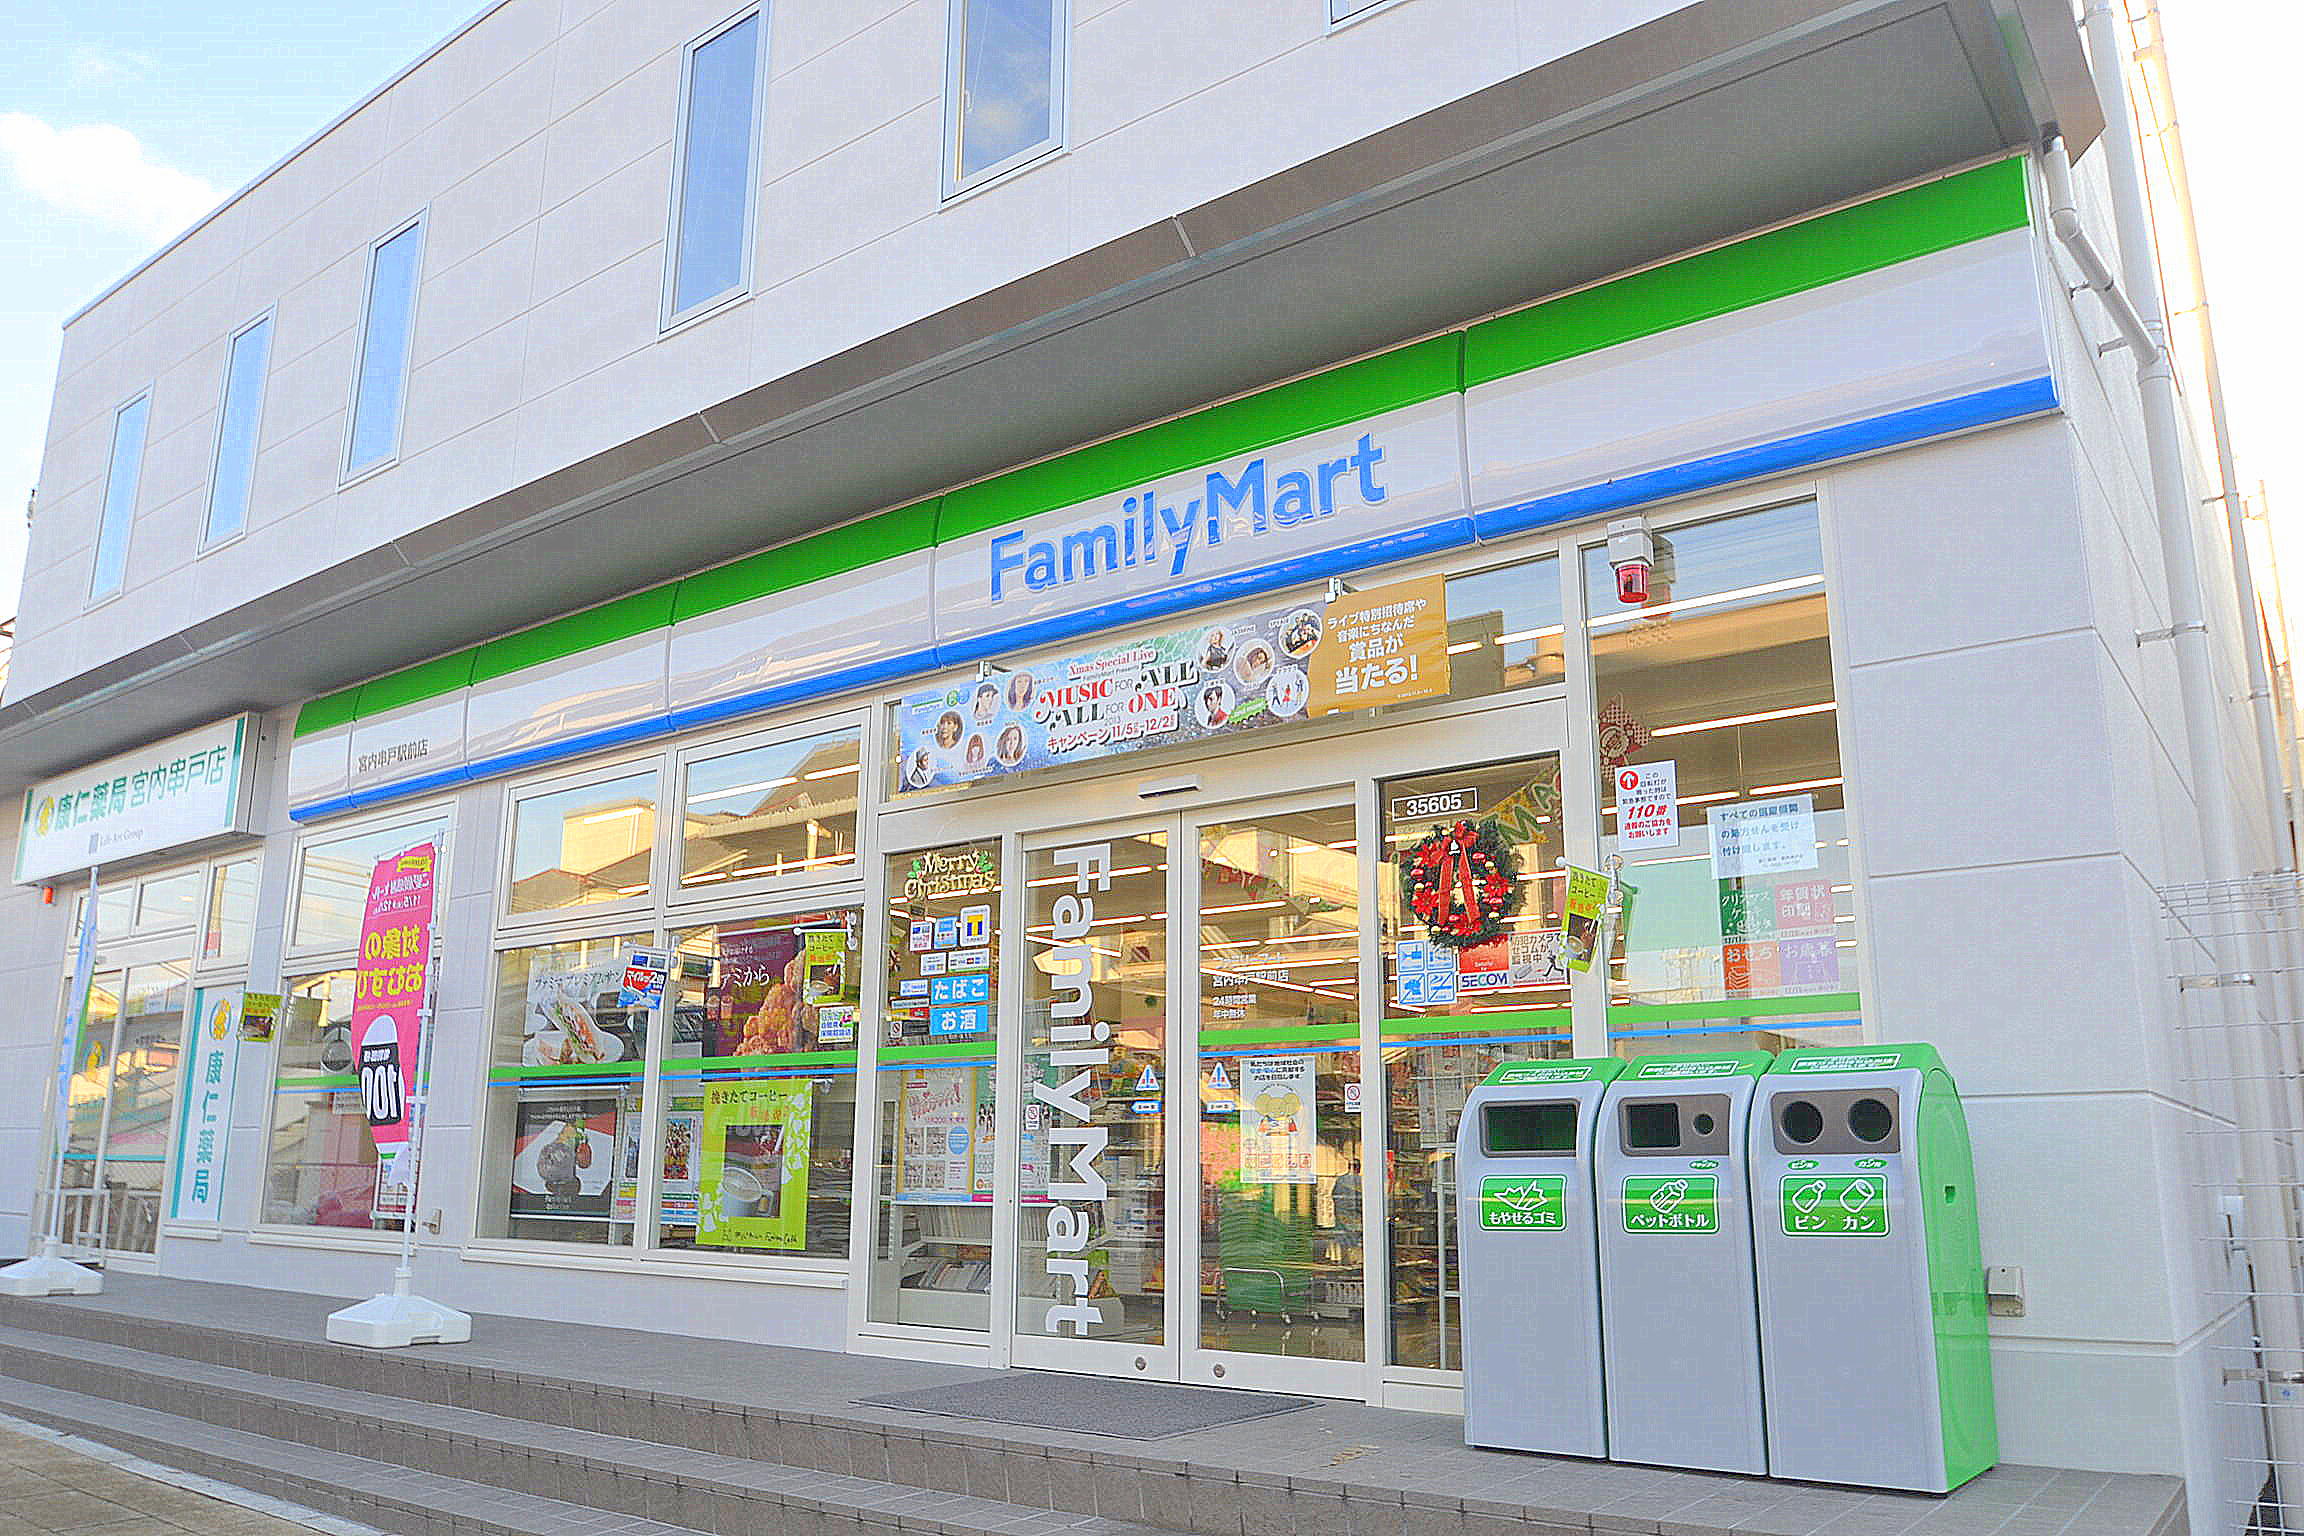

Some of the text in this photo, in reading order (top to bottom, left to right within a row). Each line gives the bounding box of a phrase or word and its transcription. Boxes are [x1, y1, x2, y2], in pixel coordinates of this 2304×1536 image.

[990, 432, 1387, 602] FamilyMart
[1327, 598, 1426, 630] ライブ特別招待席や
[1336, 615, 1415, 643] 音楽にちなんだ
[1348, 631, 1404, 662] 賞品が
[1069, 648, 1155, 675] Xmas Special Live
[1335, 654, 1418, 695] 当たる!
[1036, 660, 1196, 718] MUSIC FOR ALL
[1047, 687, 1176, 732] ALL FOR ONE
[1047, 728, 1110, 748] キャンペーン
[129, 745, 228, 808] 宮内串戸店
[1406, 793, 1462, 816] 35605
[1628, 803, 1668, 820] 110番
[923, 851, 980, 875] Merry
[904, 871, 997, 900] Christmas
[934, 978, 985, 1001] たばこ
[1461, 973, 1508, 988] SECOM
[941, 1009, 977, 1031] お酒
[1033, 841, 1112, 1337] FamilyMart
[1488, 1211, 1556, 1225] もやせるゴミ
[1631, 1213, 1710, 1228] ペットボトル
[1795, 1215, 1876, 1231] ビン カン
